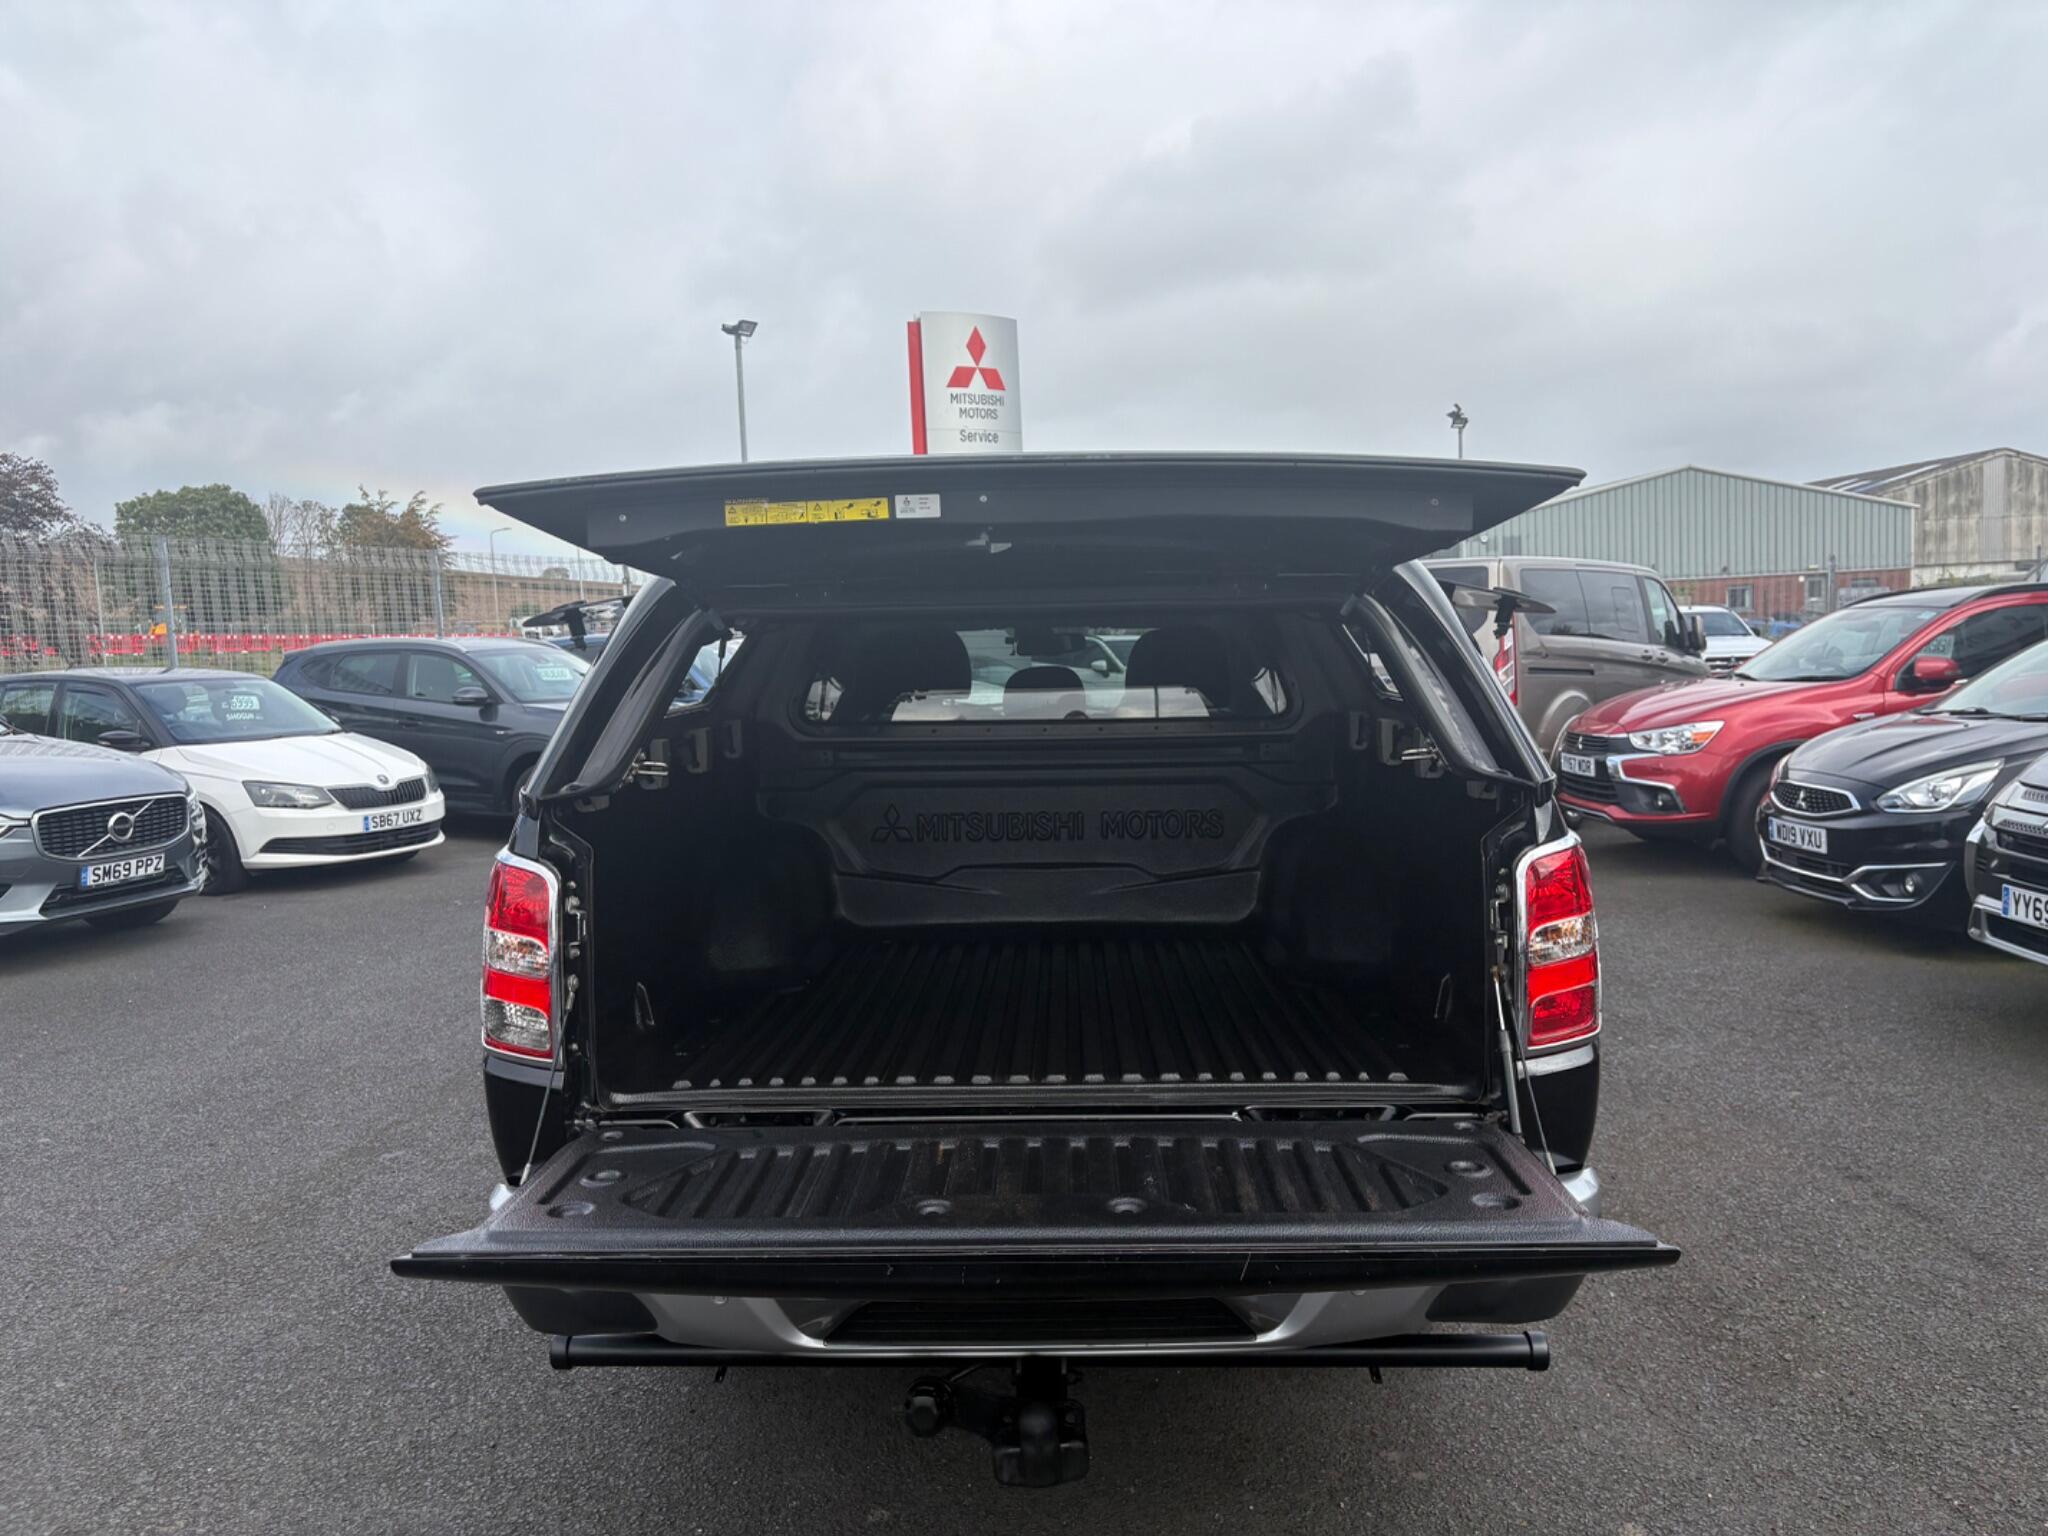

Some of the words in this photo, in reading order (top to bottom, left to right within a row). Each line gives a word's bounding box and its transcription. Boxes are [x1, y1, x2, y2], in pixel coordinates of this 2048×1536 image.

[950, 393, 1004, 406] MITSUBISHI
[959, 407, 999, 420] MOTORS
[960, 429, 999, 443] Service
[371, 813, 400, 829] SB67
[916, 810, 1084, 842] MITSUBISHI
[1100, 808, 1225, 840] MOTORS
[1800, 828, 1822, 849] VXU
[92, 861, 132, 883] SM69
[135, 855, 163, 876] PPZ
